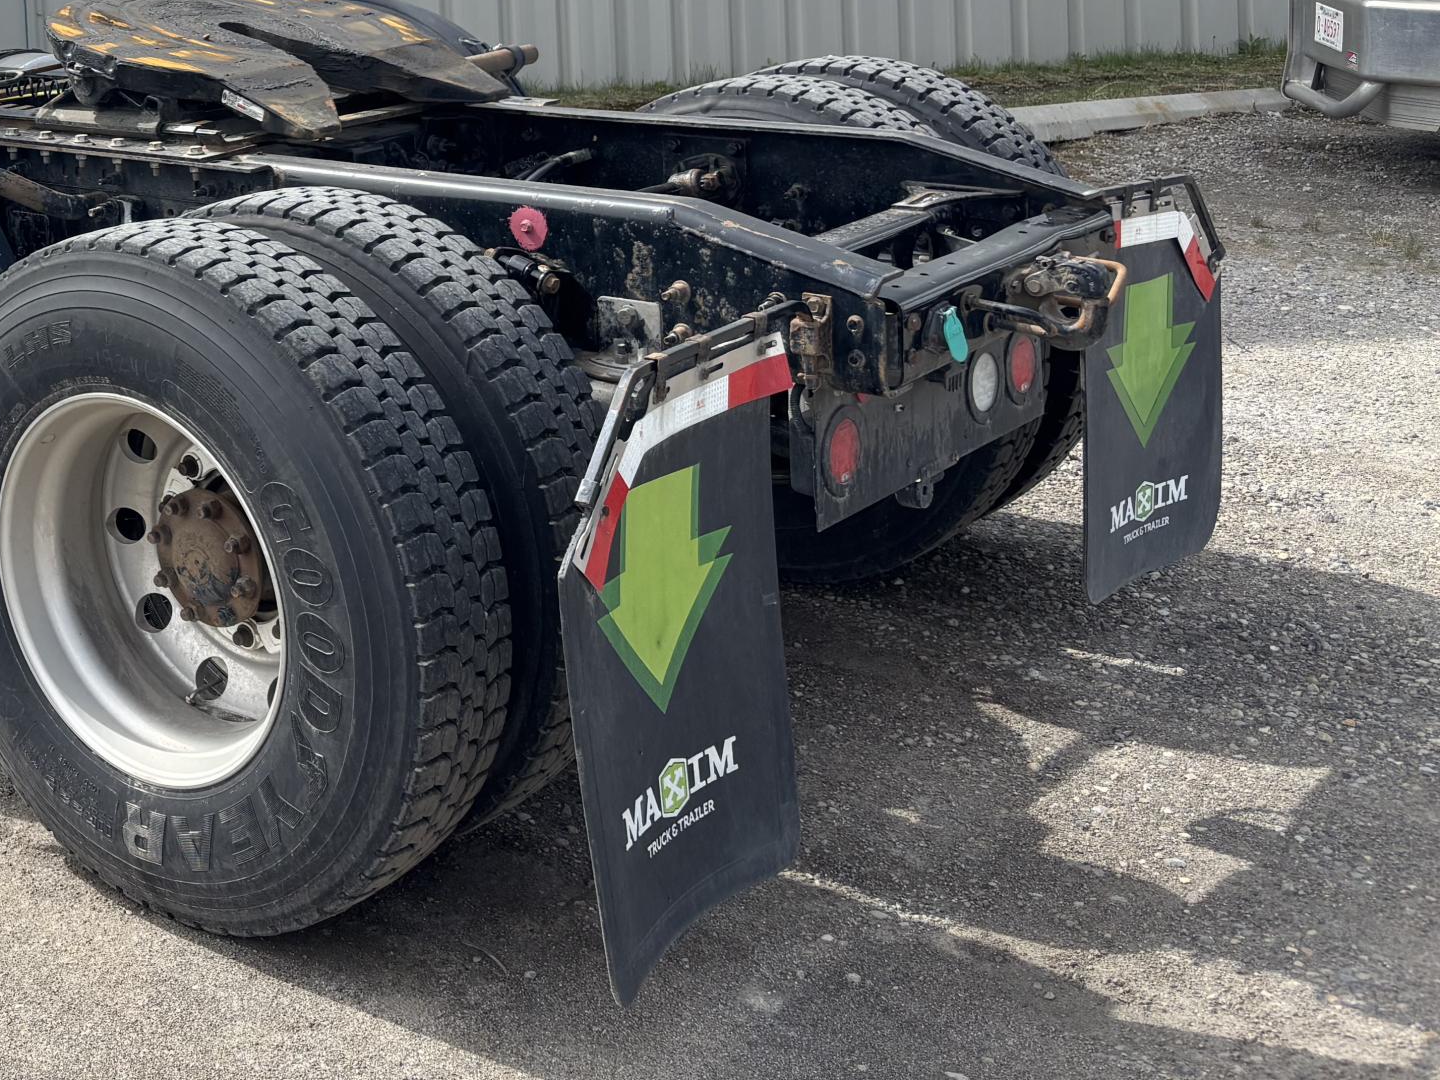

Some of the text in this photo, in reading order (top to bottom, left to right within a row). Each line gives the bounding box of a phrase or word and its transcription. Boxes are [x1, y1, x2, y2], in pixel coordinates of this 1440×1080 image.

[1110, 474, 1189, 533] MAXIM
[1123, 528, 1140, 545] TRUCK
[1144, 516, 1170, 534] TRAILER
[122, 481, 346, 872] GOODYEAR
[622, 735, 739, 851] MAXIM
[647, 827, 672, 858] TRUCK
[677, 799, 716, 832] TRAILER
